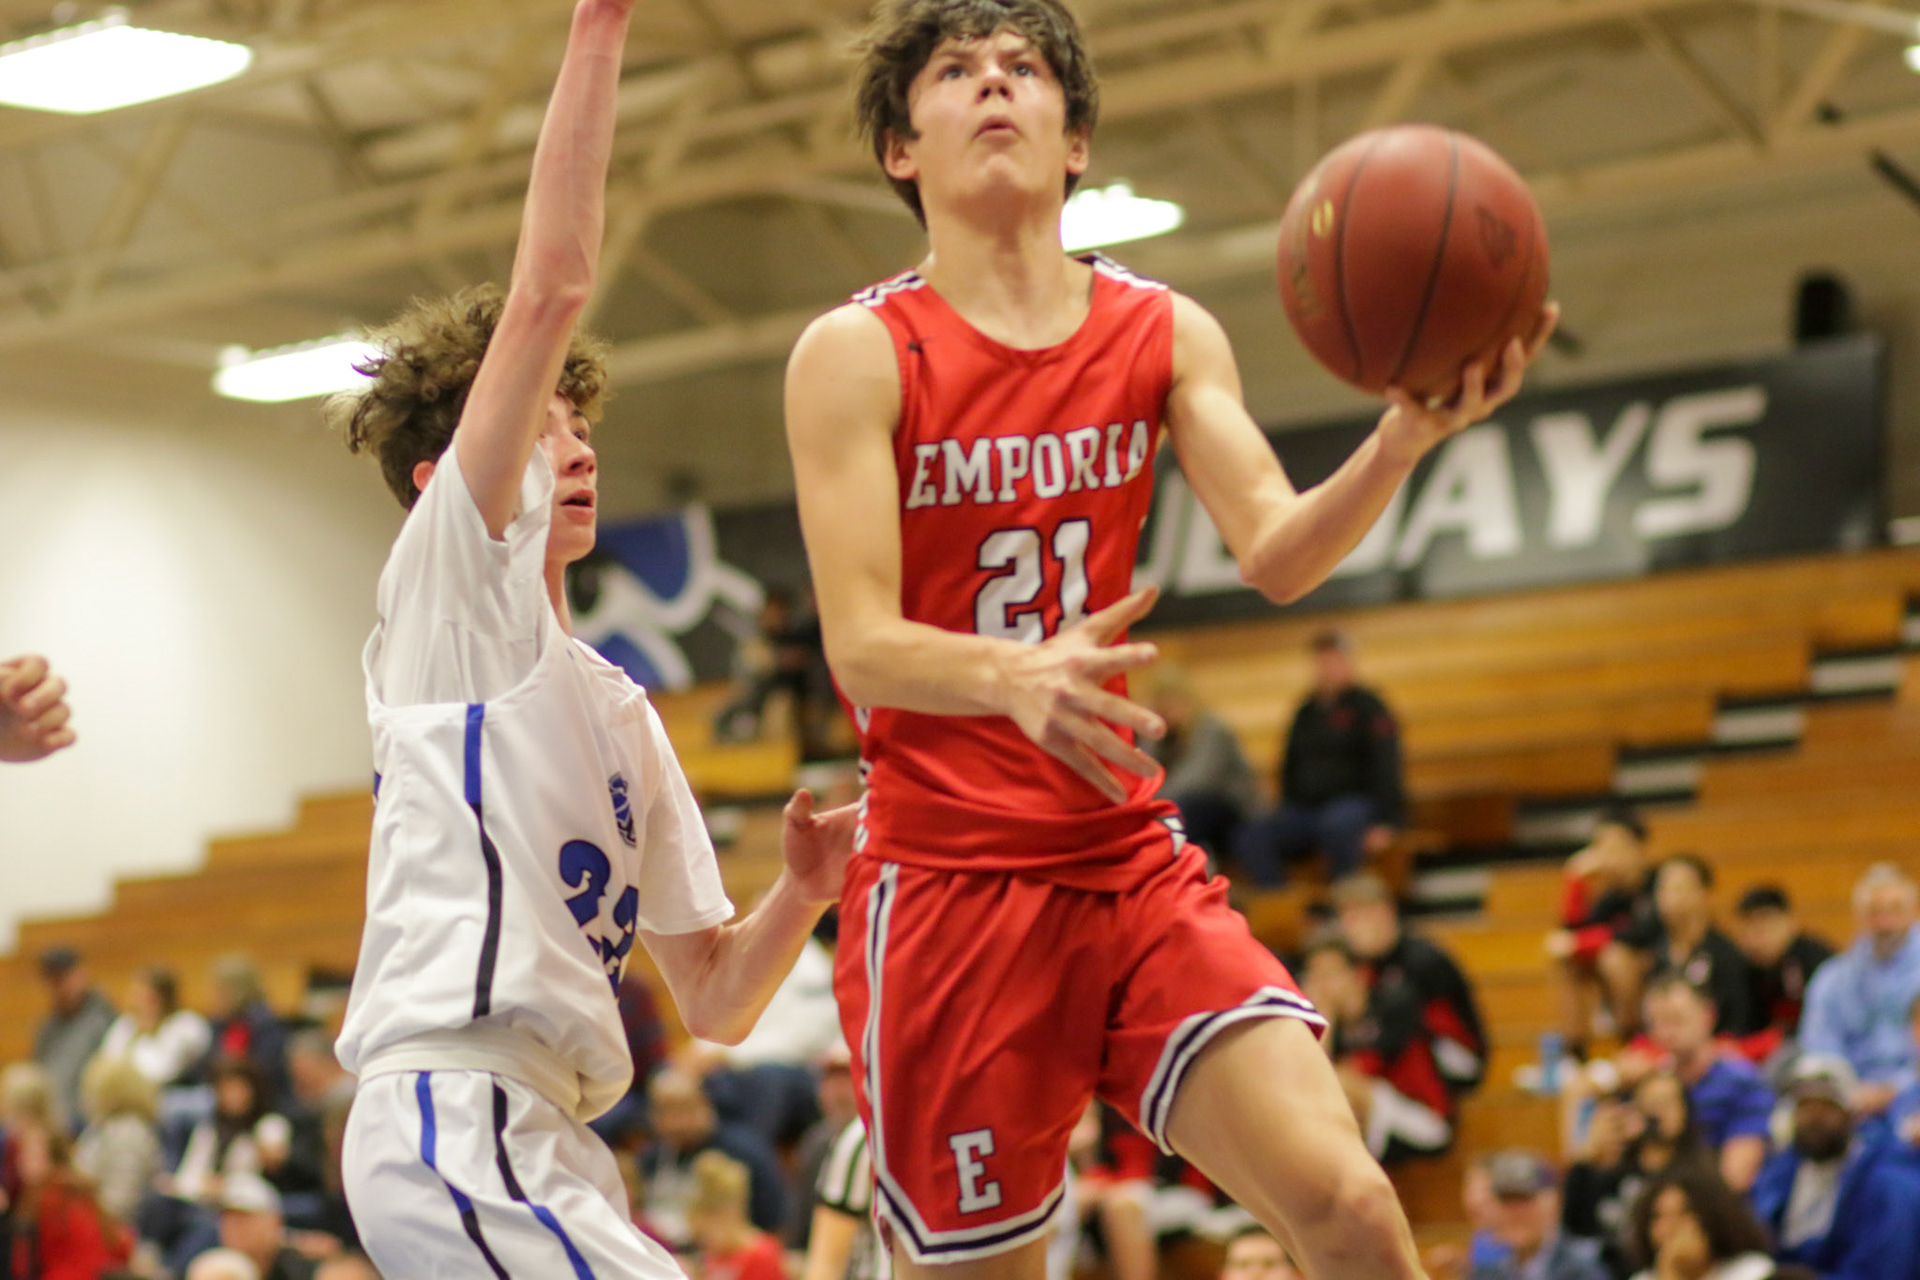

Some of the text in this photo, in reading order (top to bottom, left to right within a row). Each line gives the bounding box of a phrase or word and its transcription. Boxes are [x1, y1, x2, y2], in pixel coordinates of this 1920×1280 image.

[905, 419, 1149, 509] EMPORIA
[975, 516, 1091, 643] 21
[948, 1126, 1002, 1214] E
